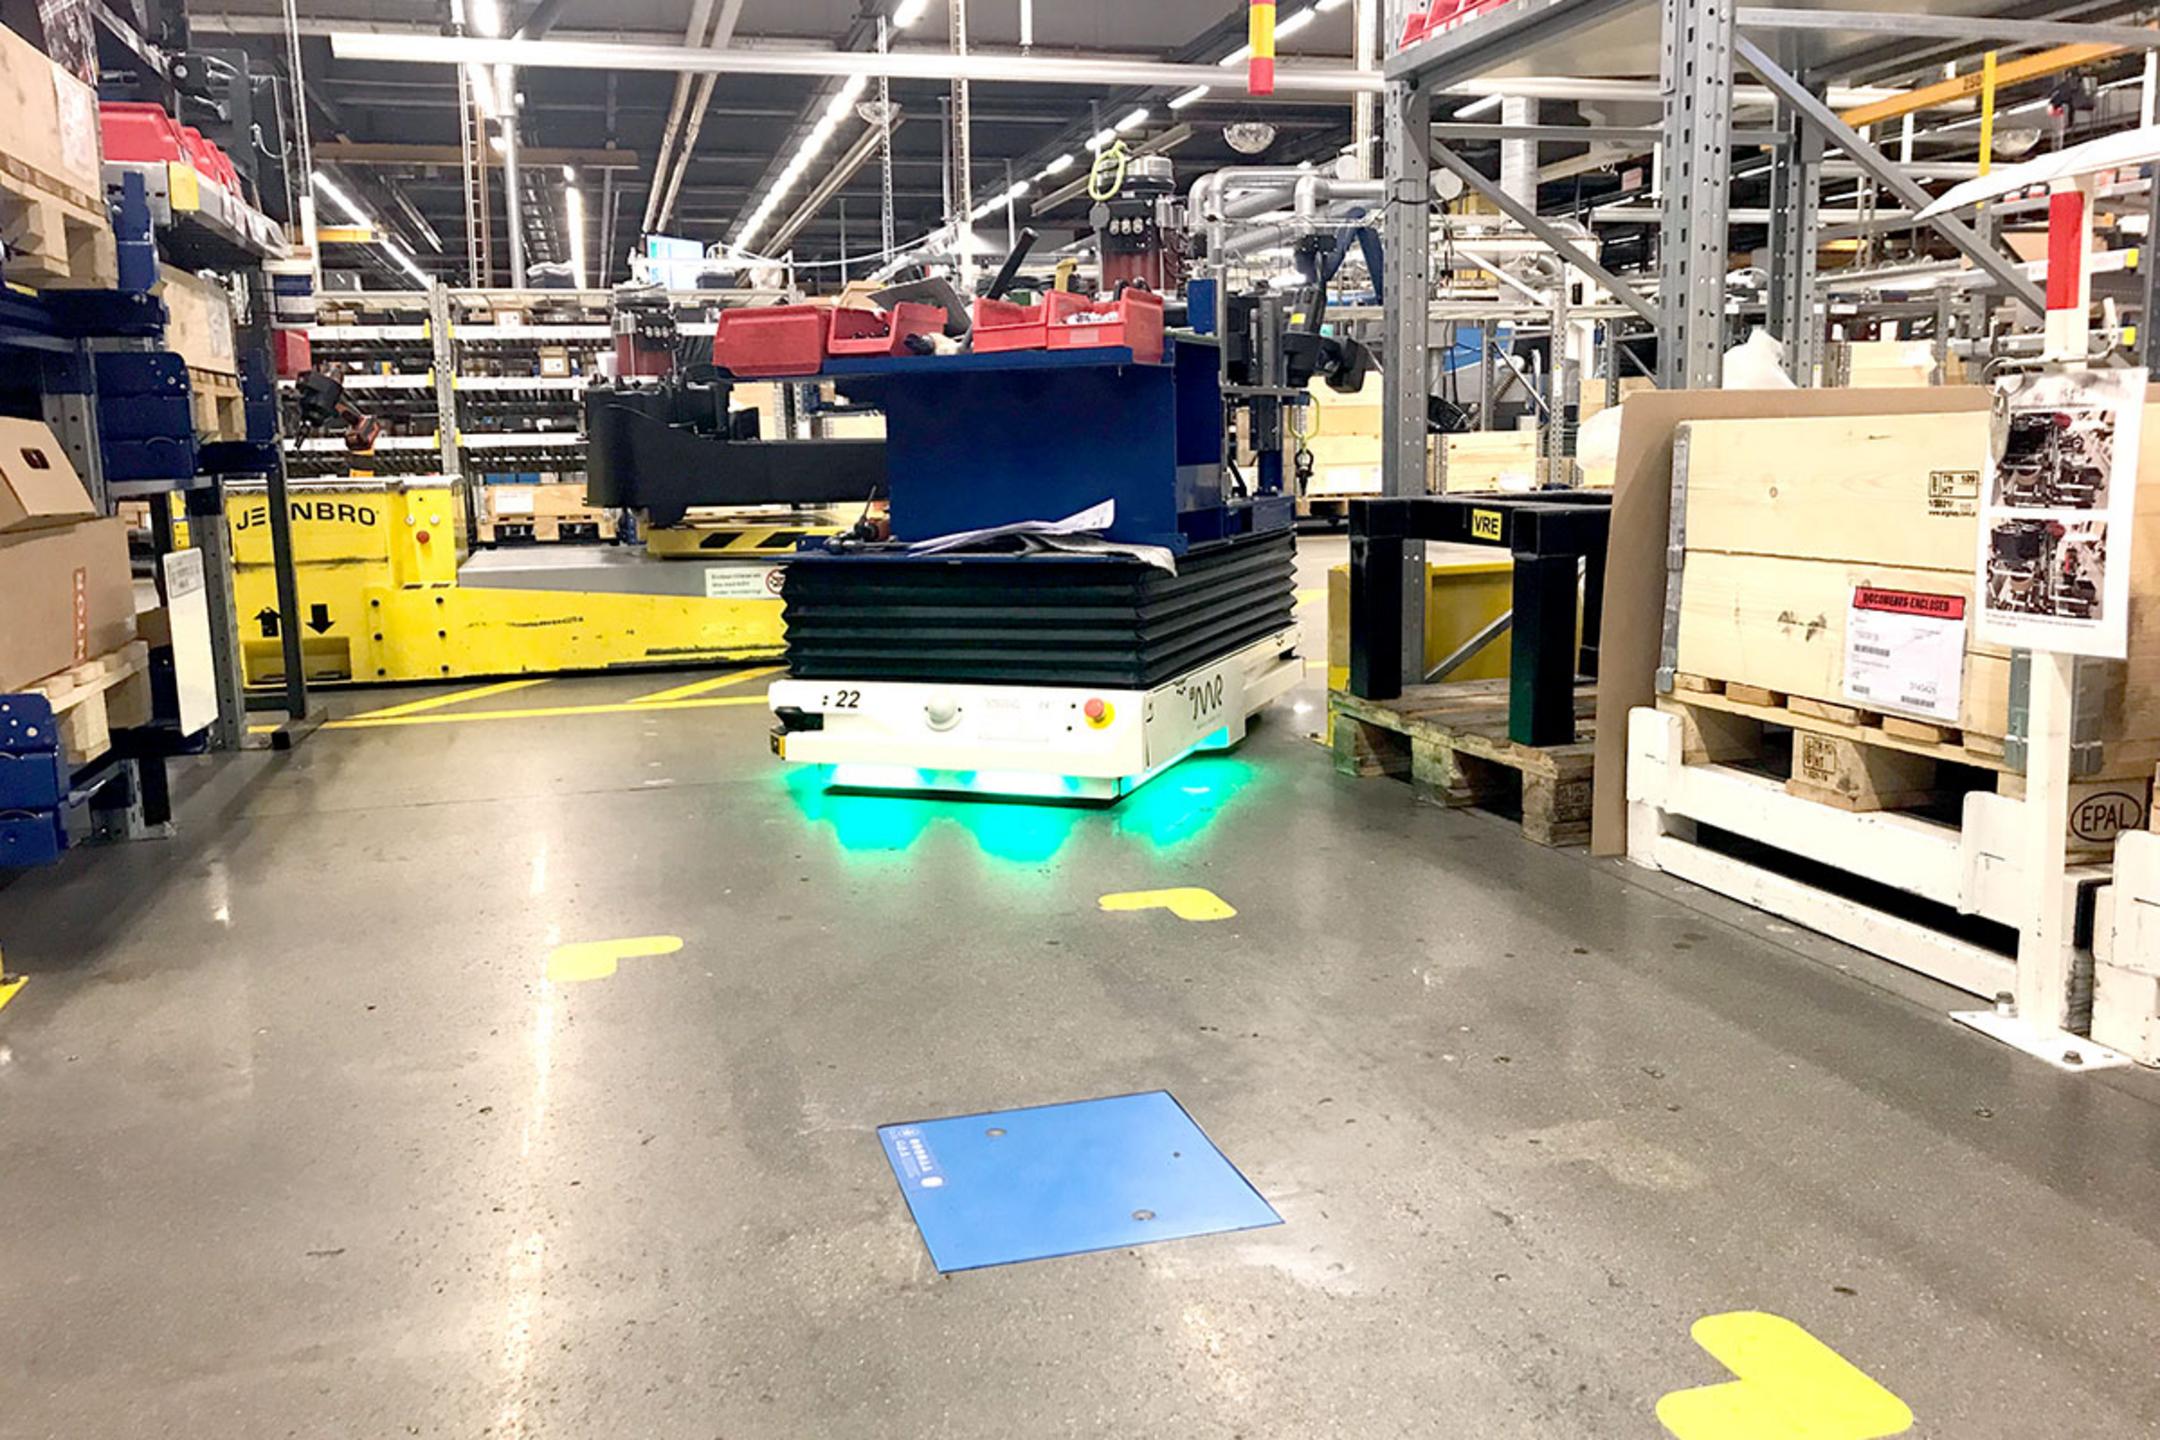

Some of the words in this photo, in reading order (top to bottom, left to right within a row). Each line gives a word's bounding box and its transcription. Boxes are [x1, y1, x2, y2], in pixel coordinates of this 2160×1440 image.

[236, 501, 376, 531] JENBRO
[1475, 515, 1499, 536] VRE
[1909, 597, 1950, 613] ENCLOSED
[2081, 802, 2130, 832] EPAL
